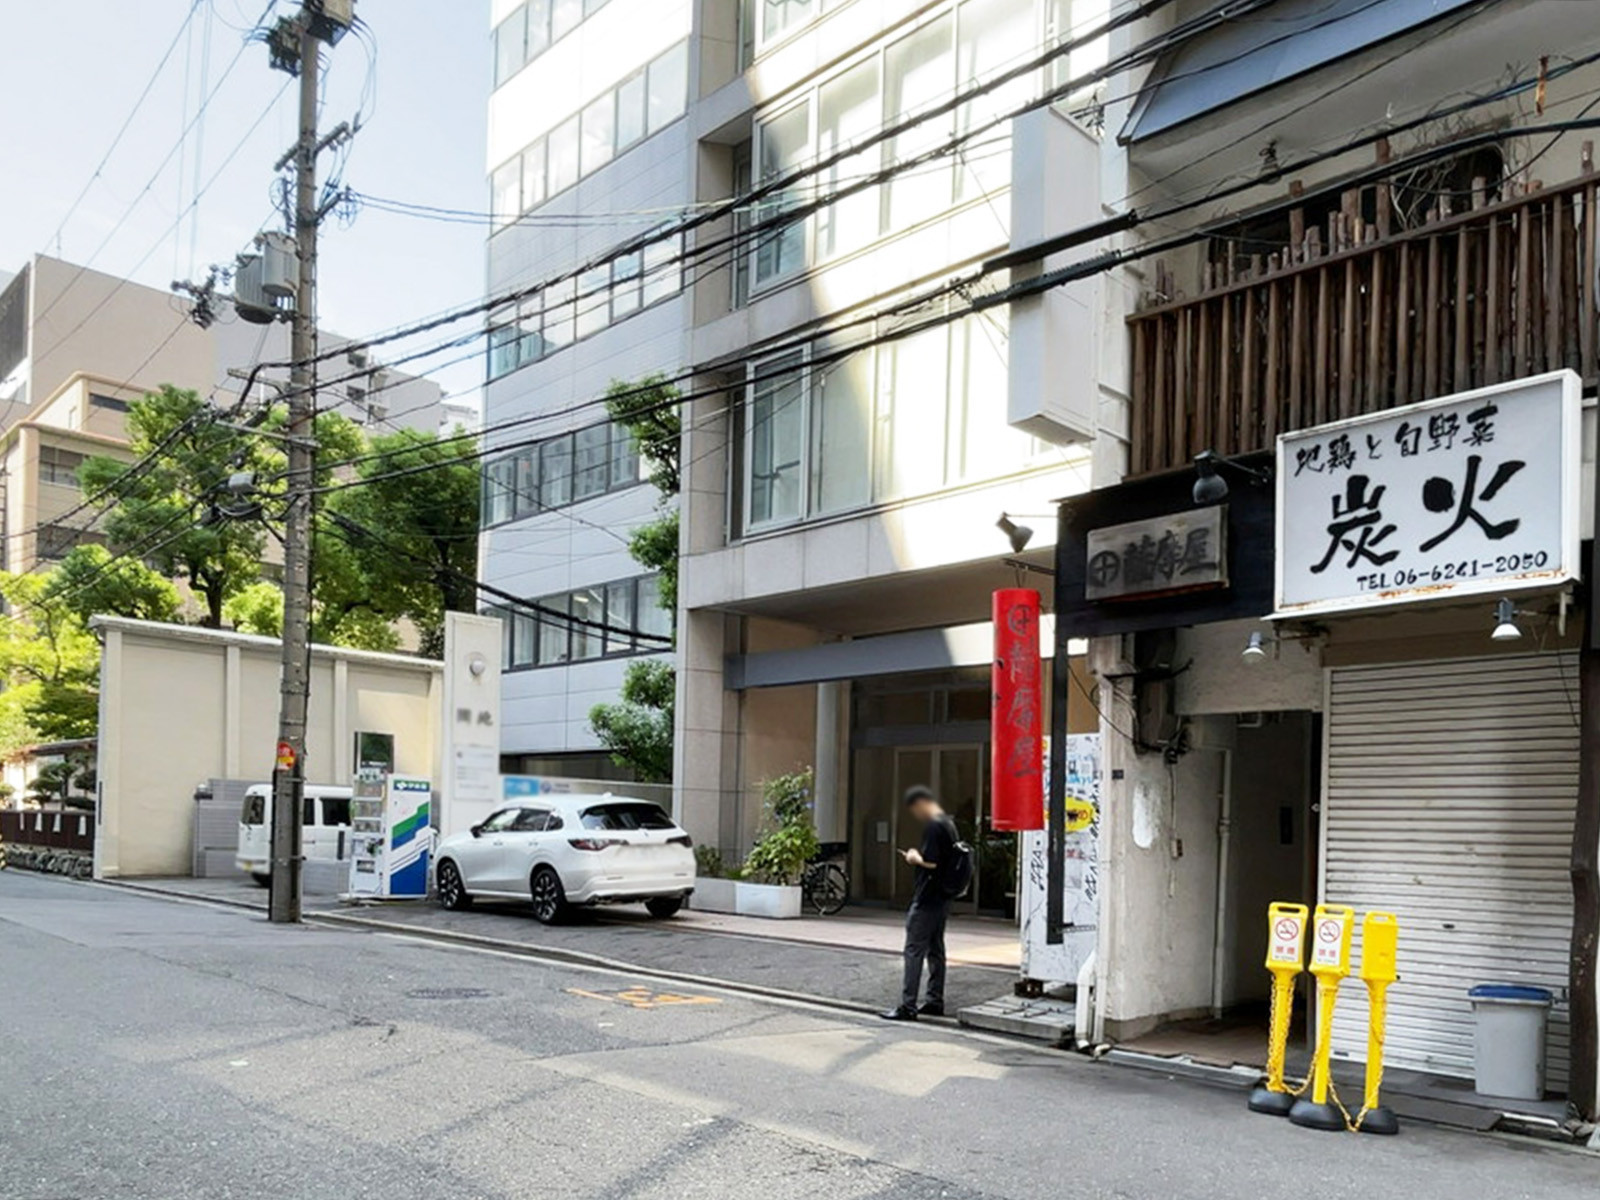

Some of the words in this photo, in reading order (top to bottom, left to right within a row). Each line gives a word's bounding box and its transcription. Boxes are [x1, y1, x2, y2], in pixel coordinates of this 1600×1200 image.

[1295, 400, 1498, 477] 地鶏と旬野菜
[1310, 455, 1526, 574] 炭火
[1357, 573, 1391, 590] TEL
